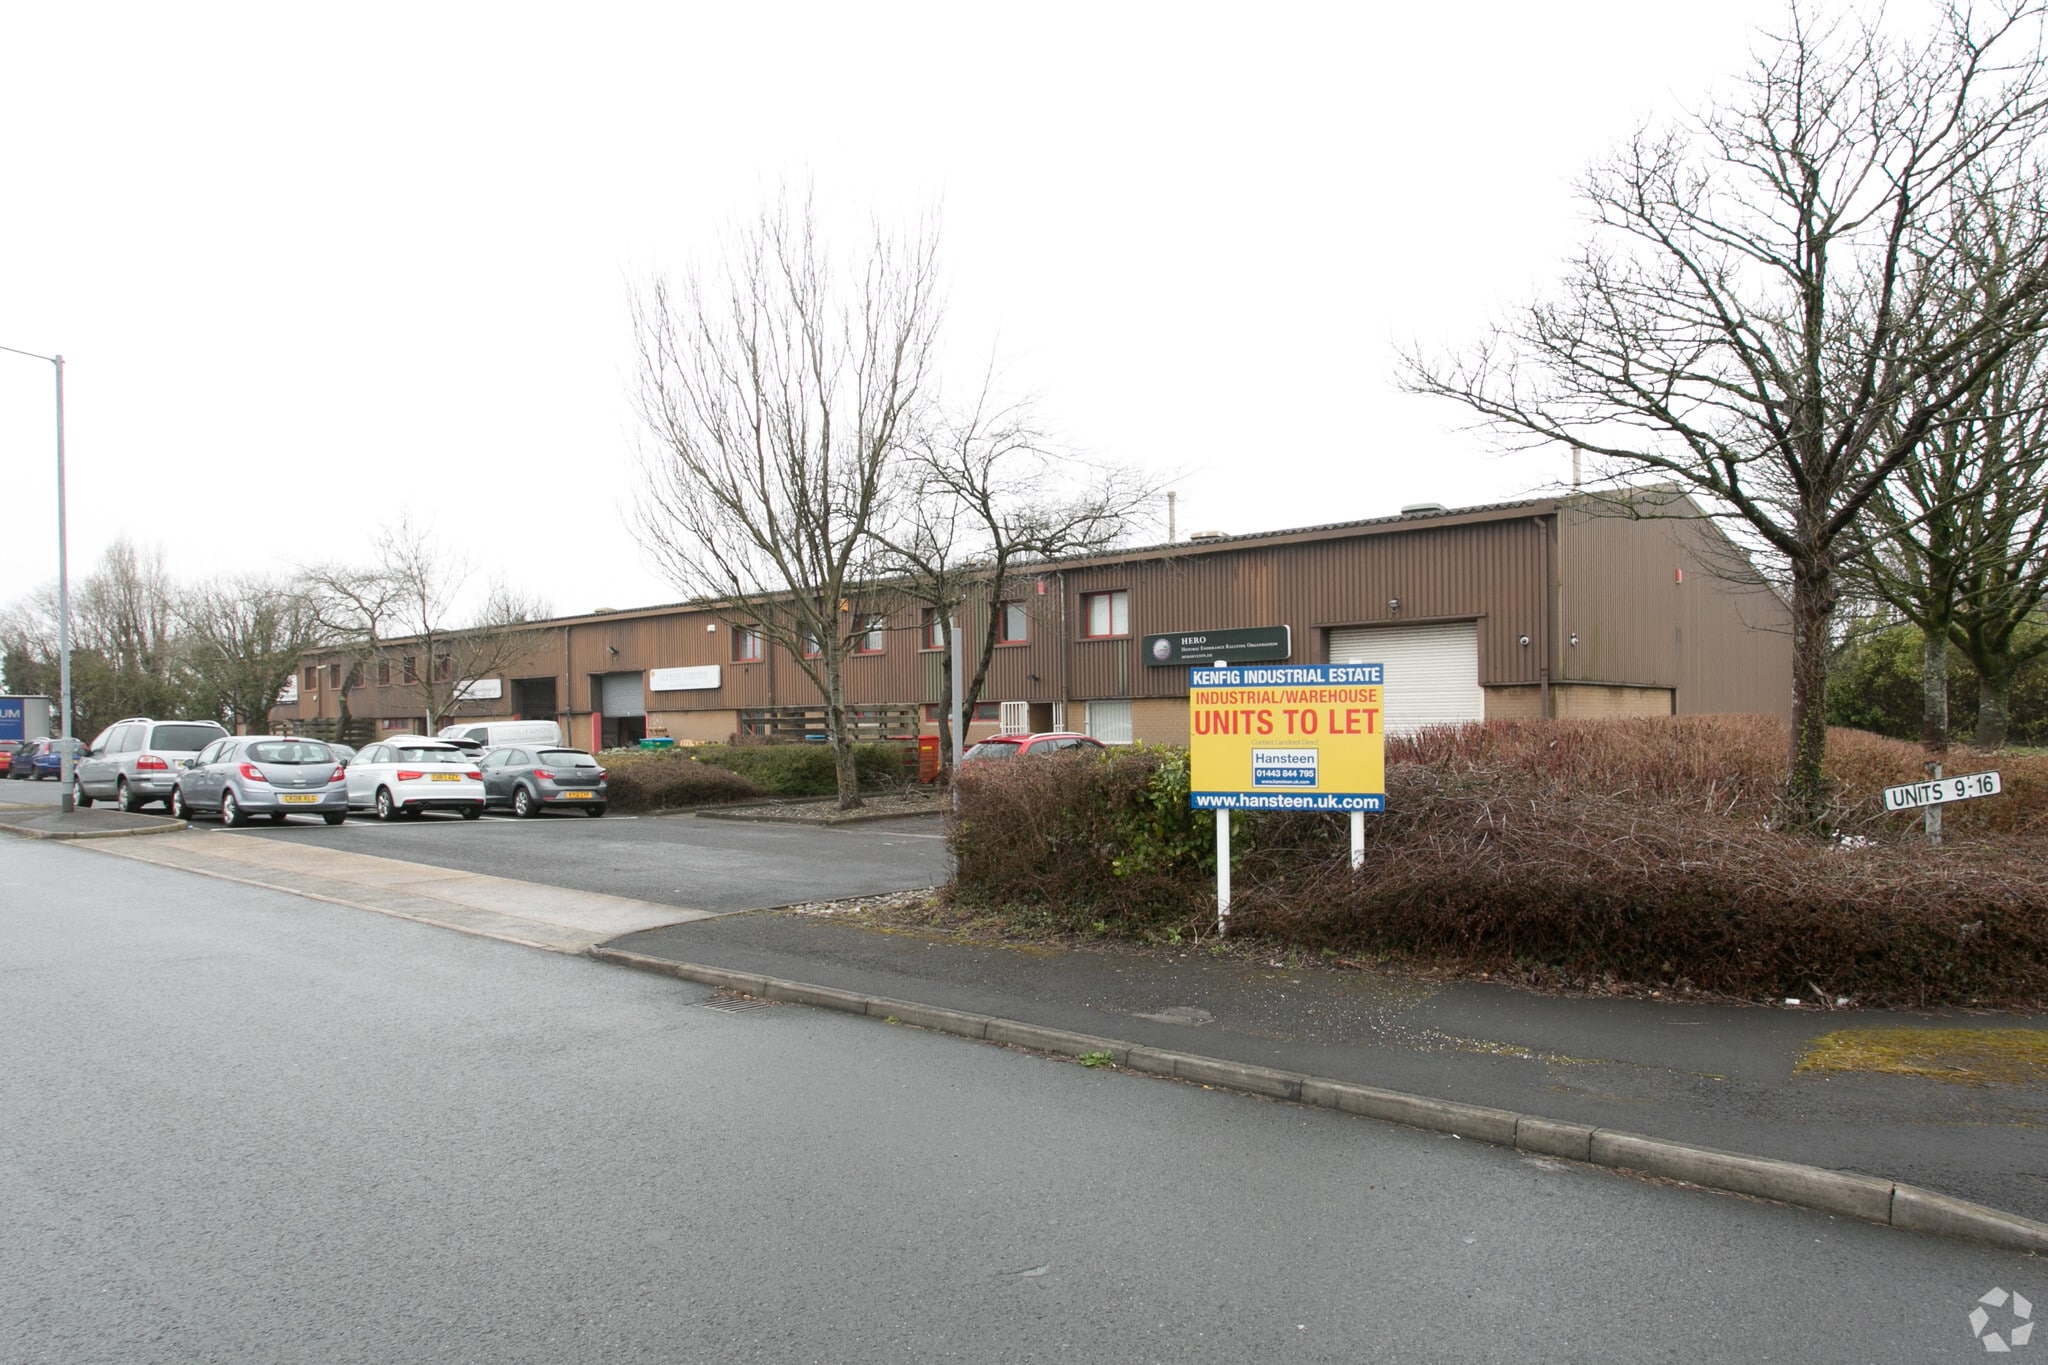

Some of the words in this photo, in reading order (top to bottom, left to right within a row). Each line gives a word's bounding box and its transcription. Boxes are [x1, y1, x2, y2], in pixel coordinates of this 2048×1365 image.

[1181, 636, 1207, 645] HERO
[1193, 670, 1240, 685] KENFIG
[1244, 668, 1325, 684] INDUSTRIAL
[1329, 667, 1380, 682] ESTATE
[1196, 689, 1377, 705] INDUSTRIAL/WAREHOUSE
[1194, 710, 1274, 735] UNITS
[1283, 709, 1318, 735] TO
[1329, 708, 1379, 735] LET
[1255, 753, 1315, 764] Hansteen
[1256, 769, 1281, 777] 01443
[1282, 769, 1297, 777] 844
[1299, 769, 1315, 778] 795
[1196, 793, 1380, 809] www.hansteen.uk.com
[1892, 783, 1943, 807] UNITS
